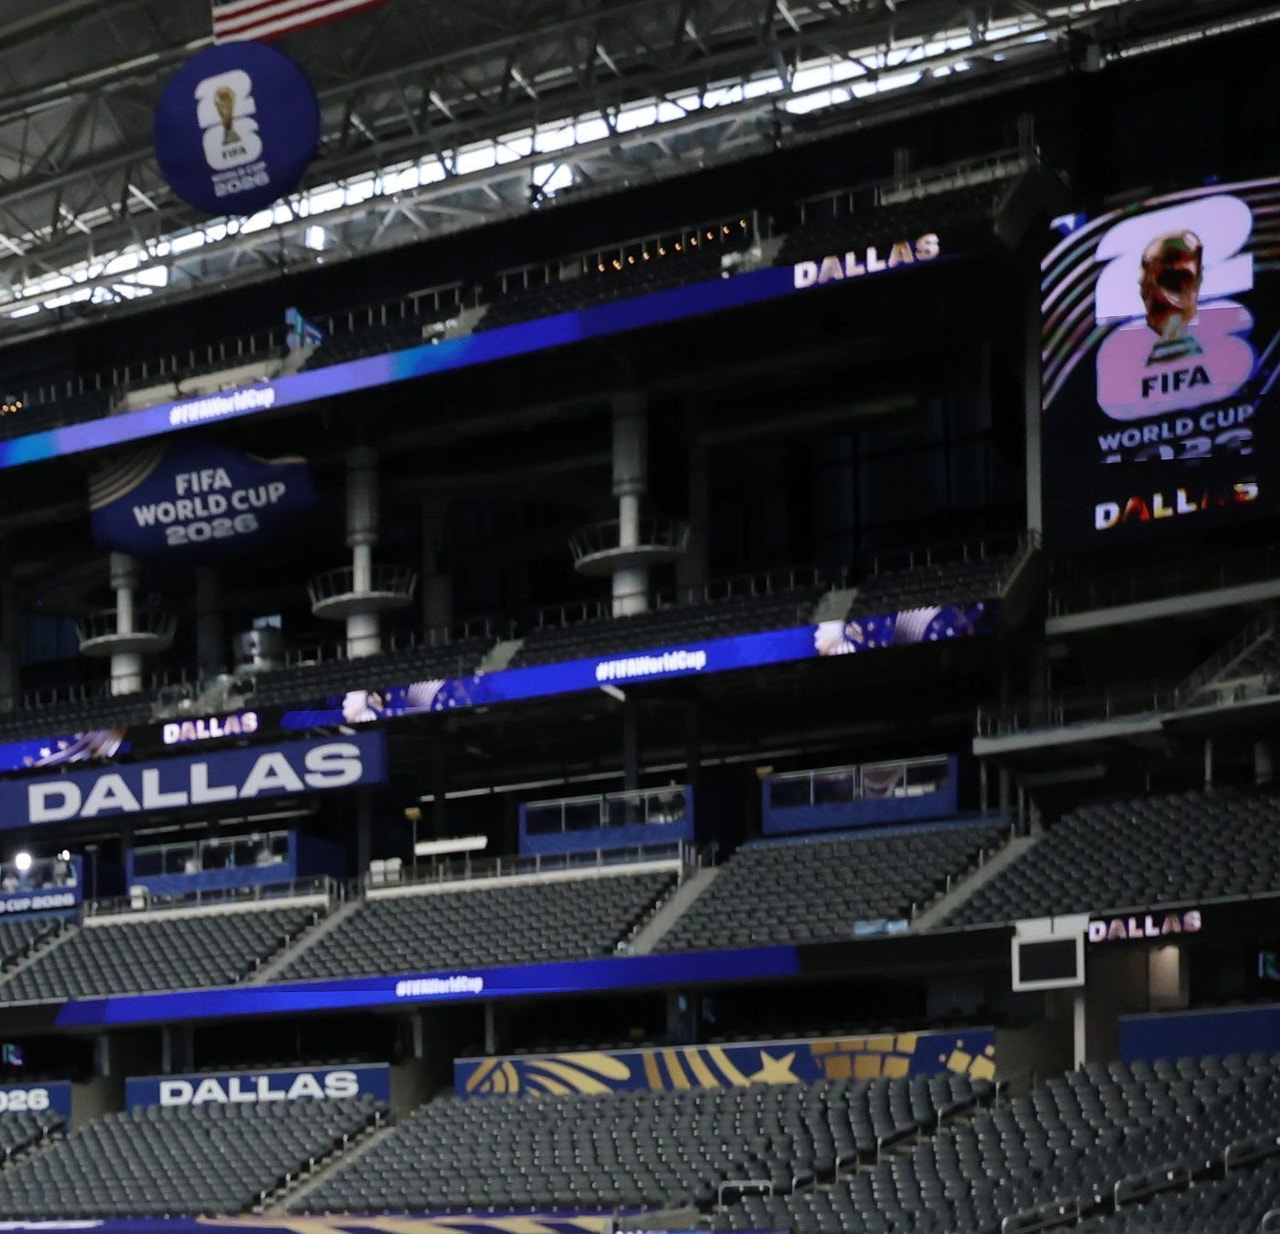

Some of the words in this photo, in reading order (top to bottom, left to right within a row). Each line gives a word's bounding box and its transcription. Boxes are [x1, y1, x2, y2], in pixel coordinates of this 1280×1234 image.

[794, 232, 939, 289] DALLAS
[1142, 365, 1210, 398] FIFA
[1097, 417, 1194, 451] WORLD
[1199, 404, 1254, 431] CUP
[176, 468, 231, 496] FIFA
[133, 495, 227, 527] WORLD
[232, 482, 285, 510] CUP
[1095, 482, 1258, 530] DALLS
[166, 515, 258, 546] 2026
[163, 712, 258, 744] DALLAS
[28, 743, 363, 823] DALLAS
[1089, 910, 1202, 942] DALLAS
[160, 1071, 359, 1106] DALLAS
